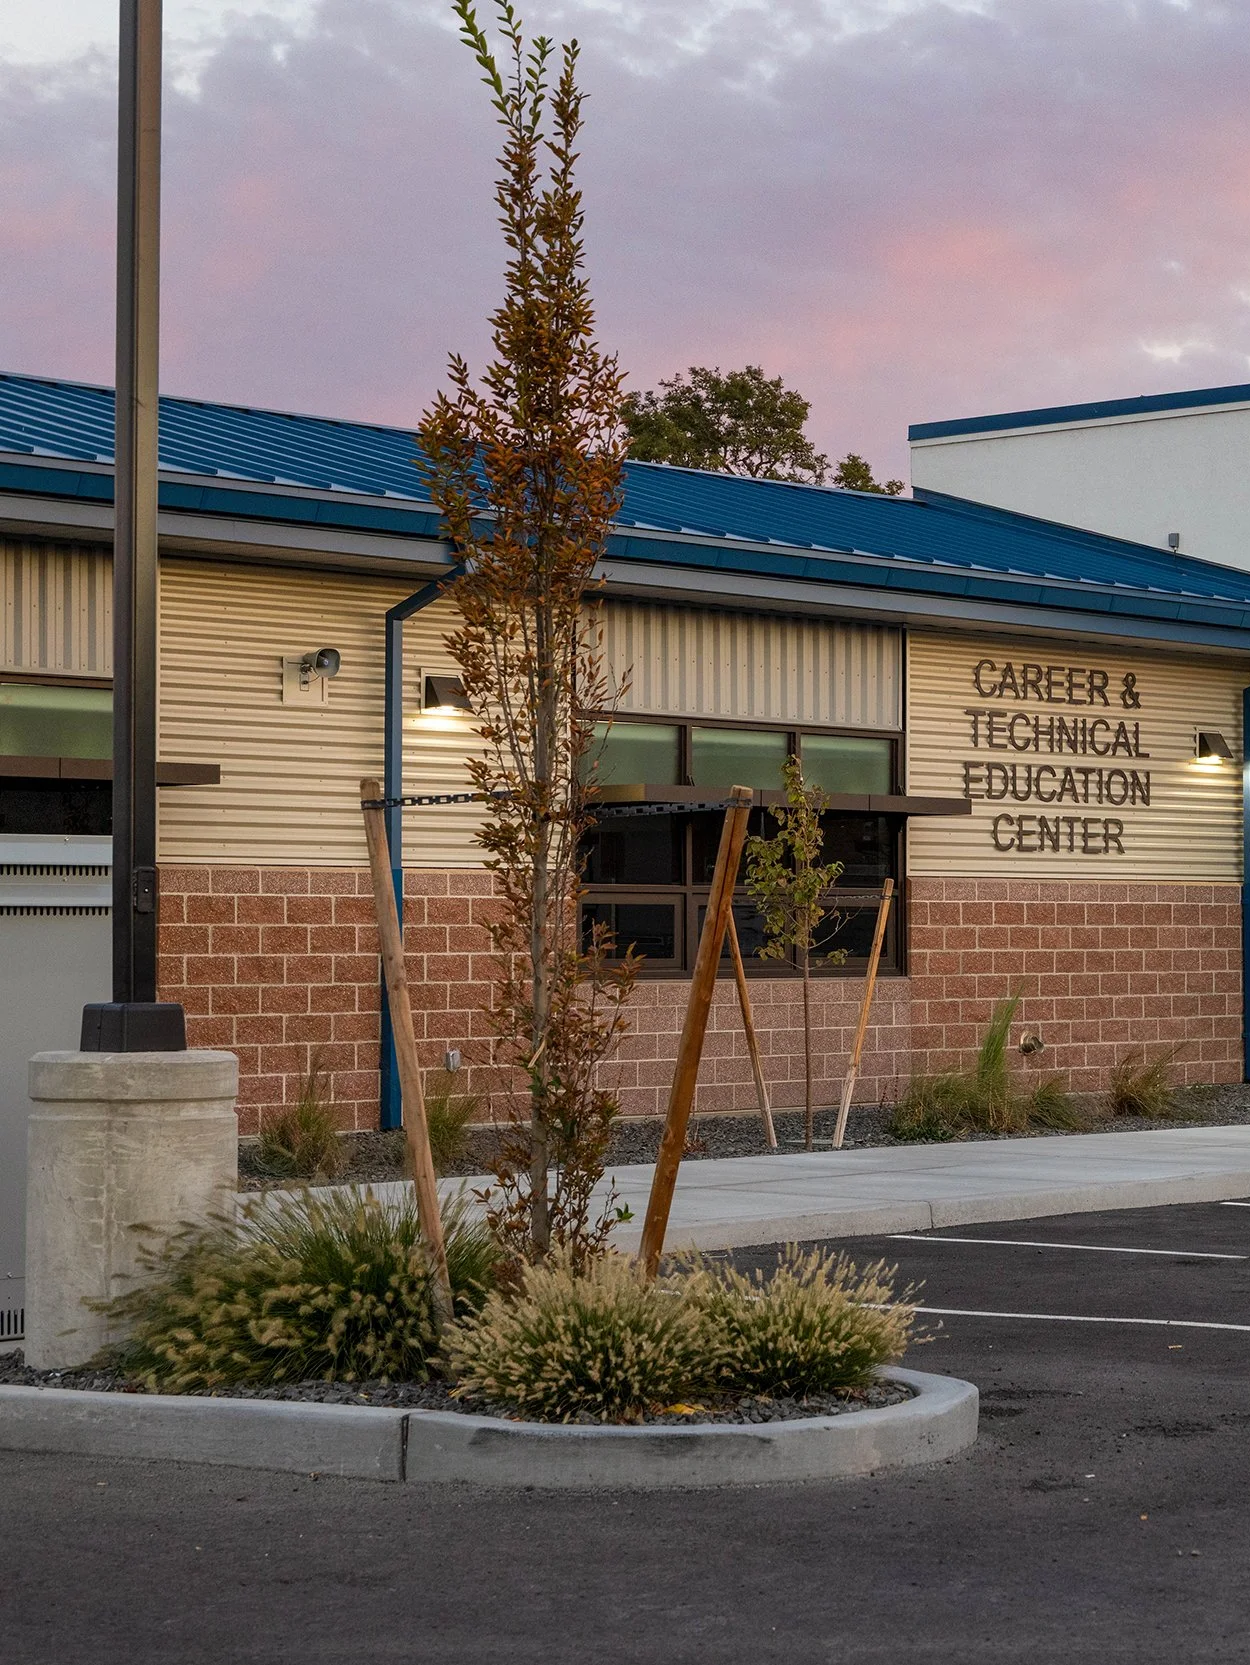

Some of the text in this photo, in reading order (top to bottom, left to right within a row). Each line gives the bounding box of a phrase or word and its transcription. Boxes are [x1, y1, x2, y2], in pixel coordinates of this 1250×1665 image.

[974, 659, 1142, 709] CAREER &
[964, 709, 1150, 758] TECHNICAL
[964, 761, 1151, 806] EDUCATION
[992, 813, 1125, 854] CENTER
